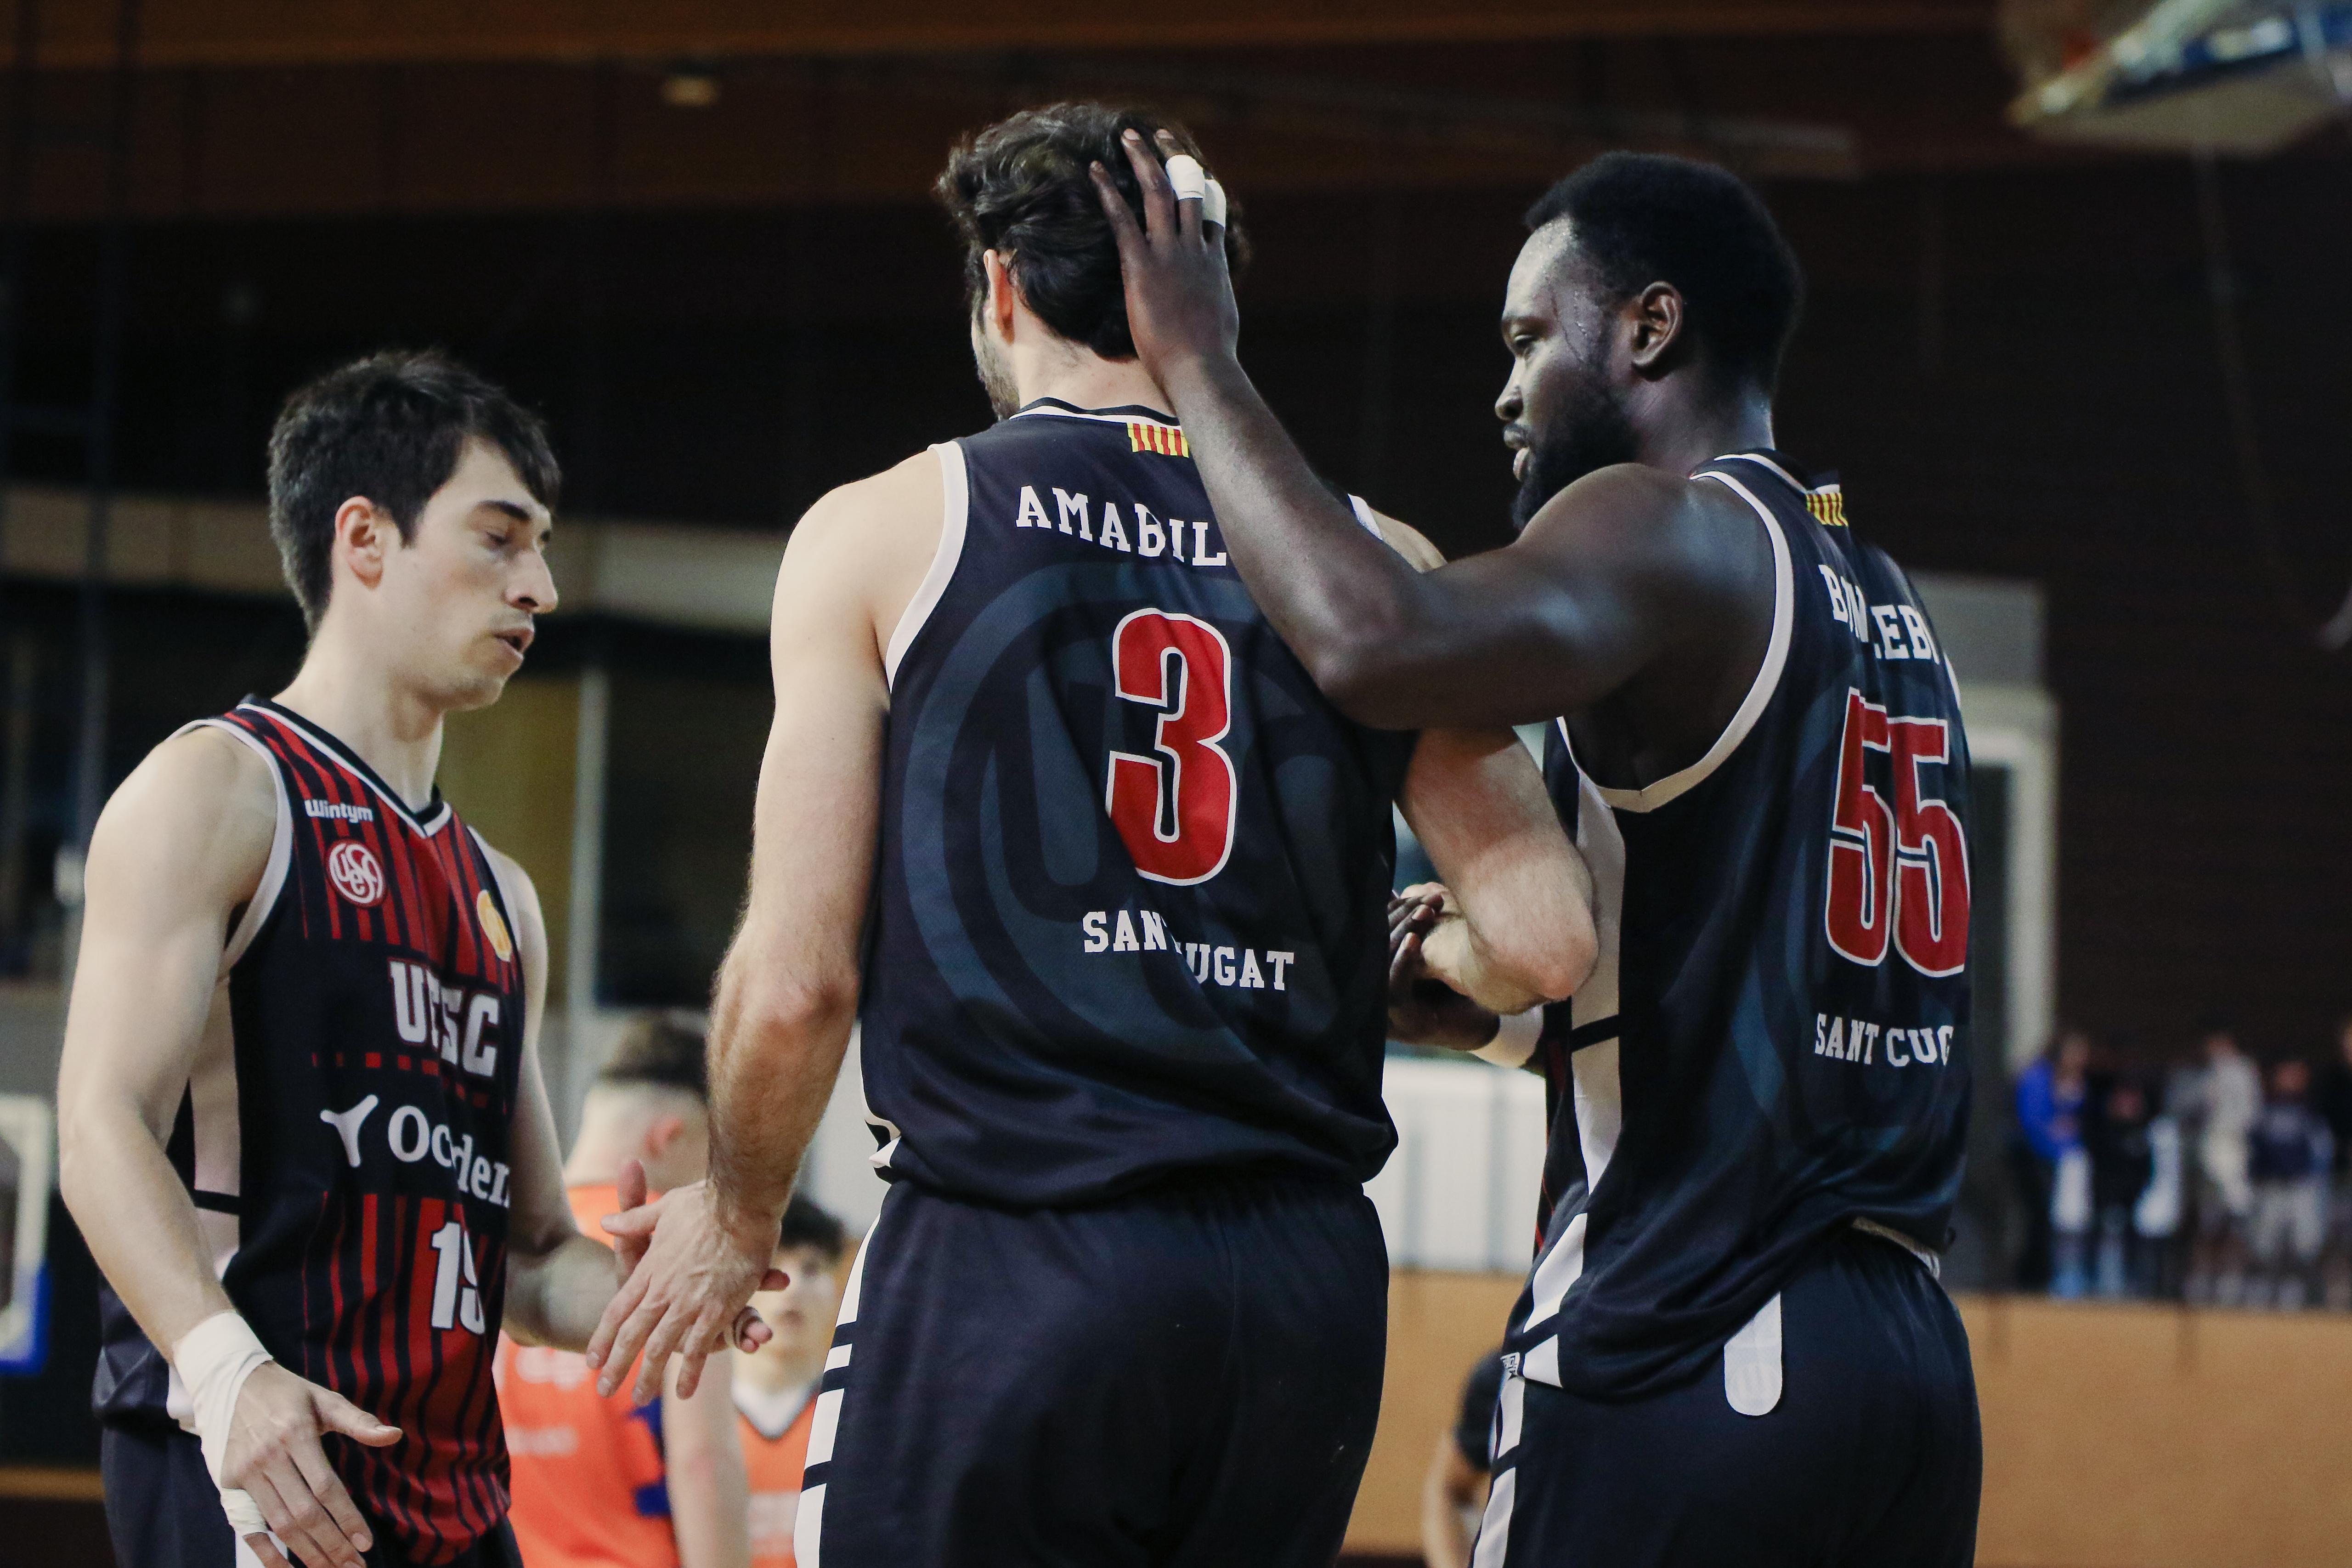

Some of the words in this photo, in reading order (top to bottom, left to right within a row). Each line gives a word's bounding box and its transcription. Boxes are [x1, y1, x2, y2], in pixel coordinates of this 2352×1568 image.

[1105, 607, 1237, 886] 3
[1825, 686, 1970, 978] 55
[1083, 910, 1168, 952] SAN
[1175, 941, 1295, 991] UGAT
[1815, 1013, 1879, 1065] SANT
